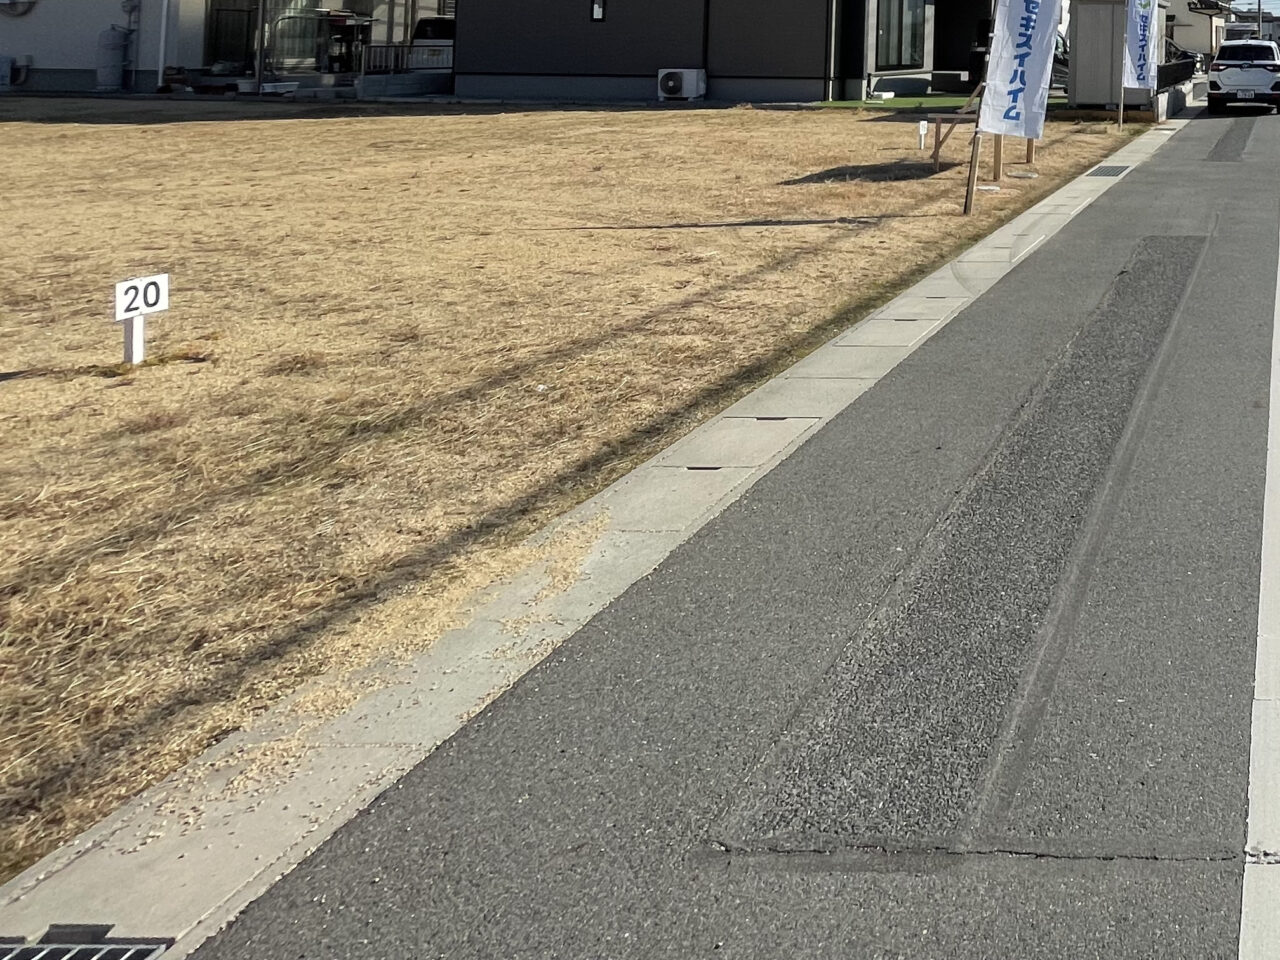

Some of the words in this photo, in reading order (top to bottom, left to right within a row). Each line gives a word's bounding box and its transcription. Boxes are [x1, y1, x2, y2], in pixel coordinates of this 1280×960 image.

[1136, 14, 1149, 81] セキスイハイム
[123, 281, 160, 313] 20
